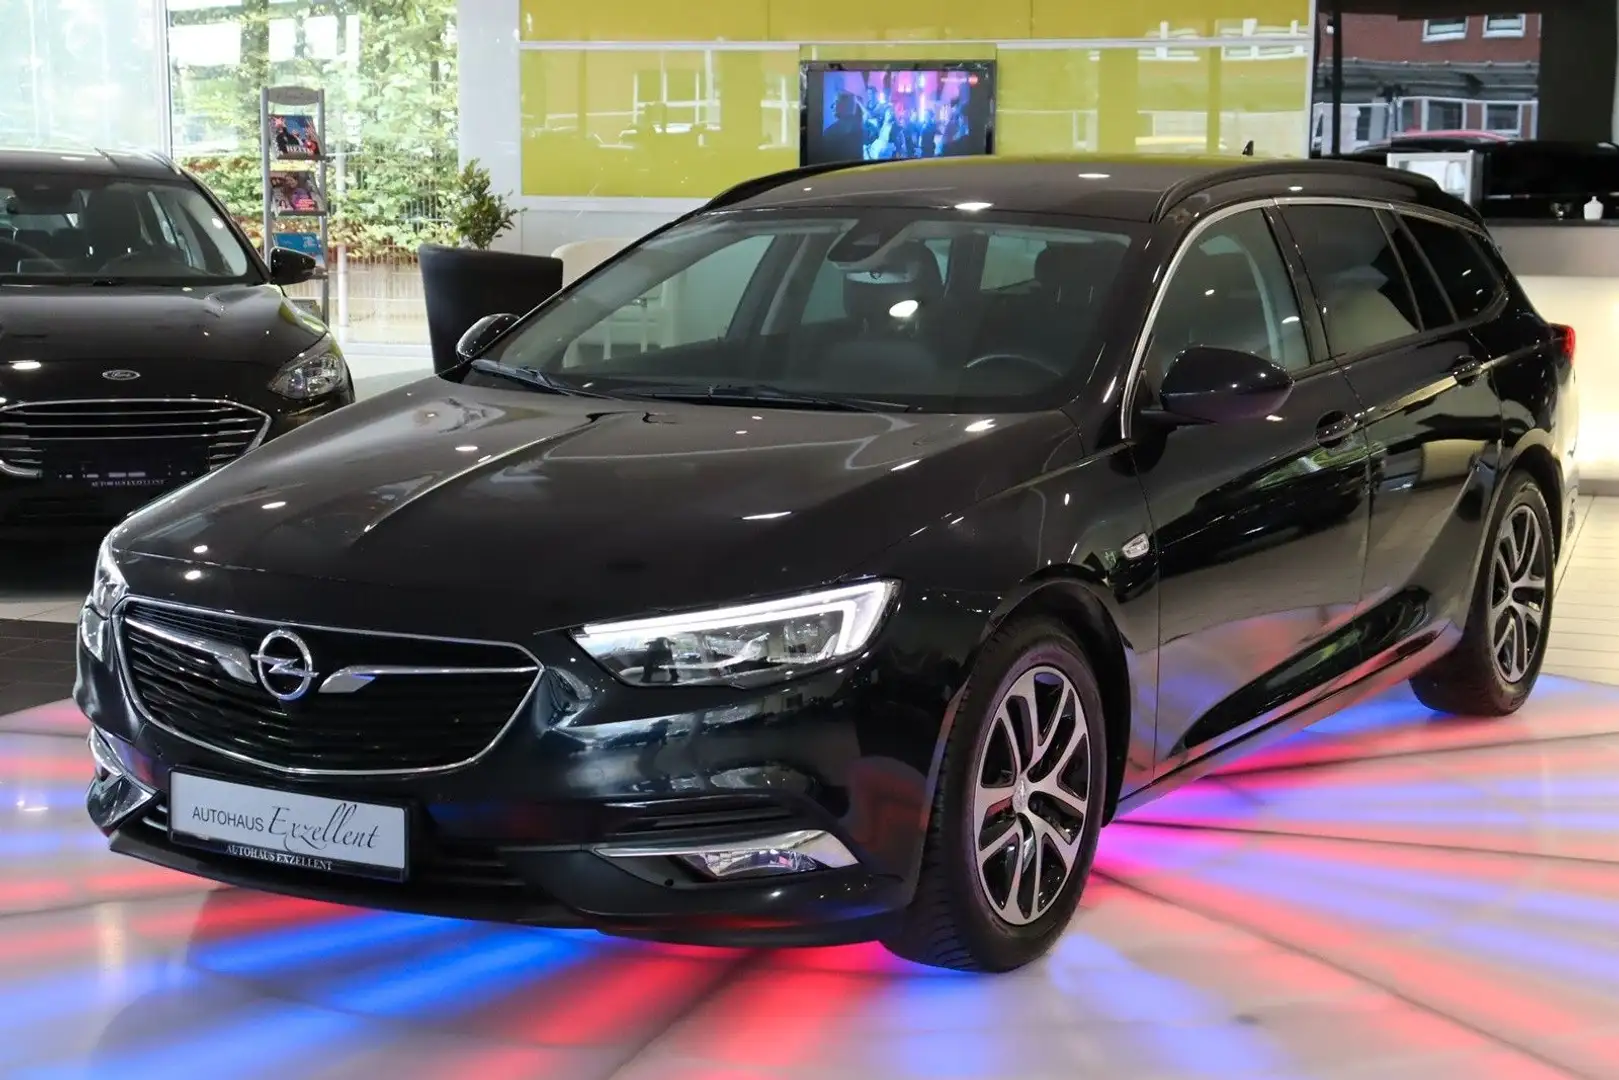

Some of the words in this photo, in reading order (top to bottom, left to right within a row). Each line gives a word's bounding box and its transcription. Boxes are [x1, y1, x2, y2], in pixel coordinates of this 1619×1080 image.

[192, 806, 265, 832] AUTOHAUS
[268, 802, 380, 852] Exzellent
[226, 845, 275, 862] AUTOHAUS
[276, 853, 333, 870] EXZELLENT
